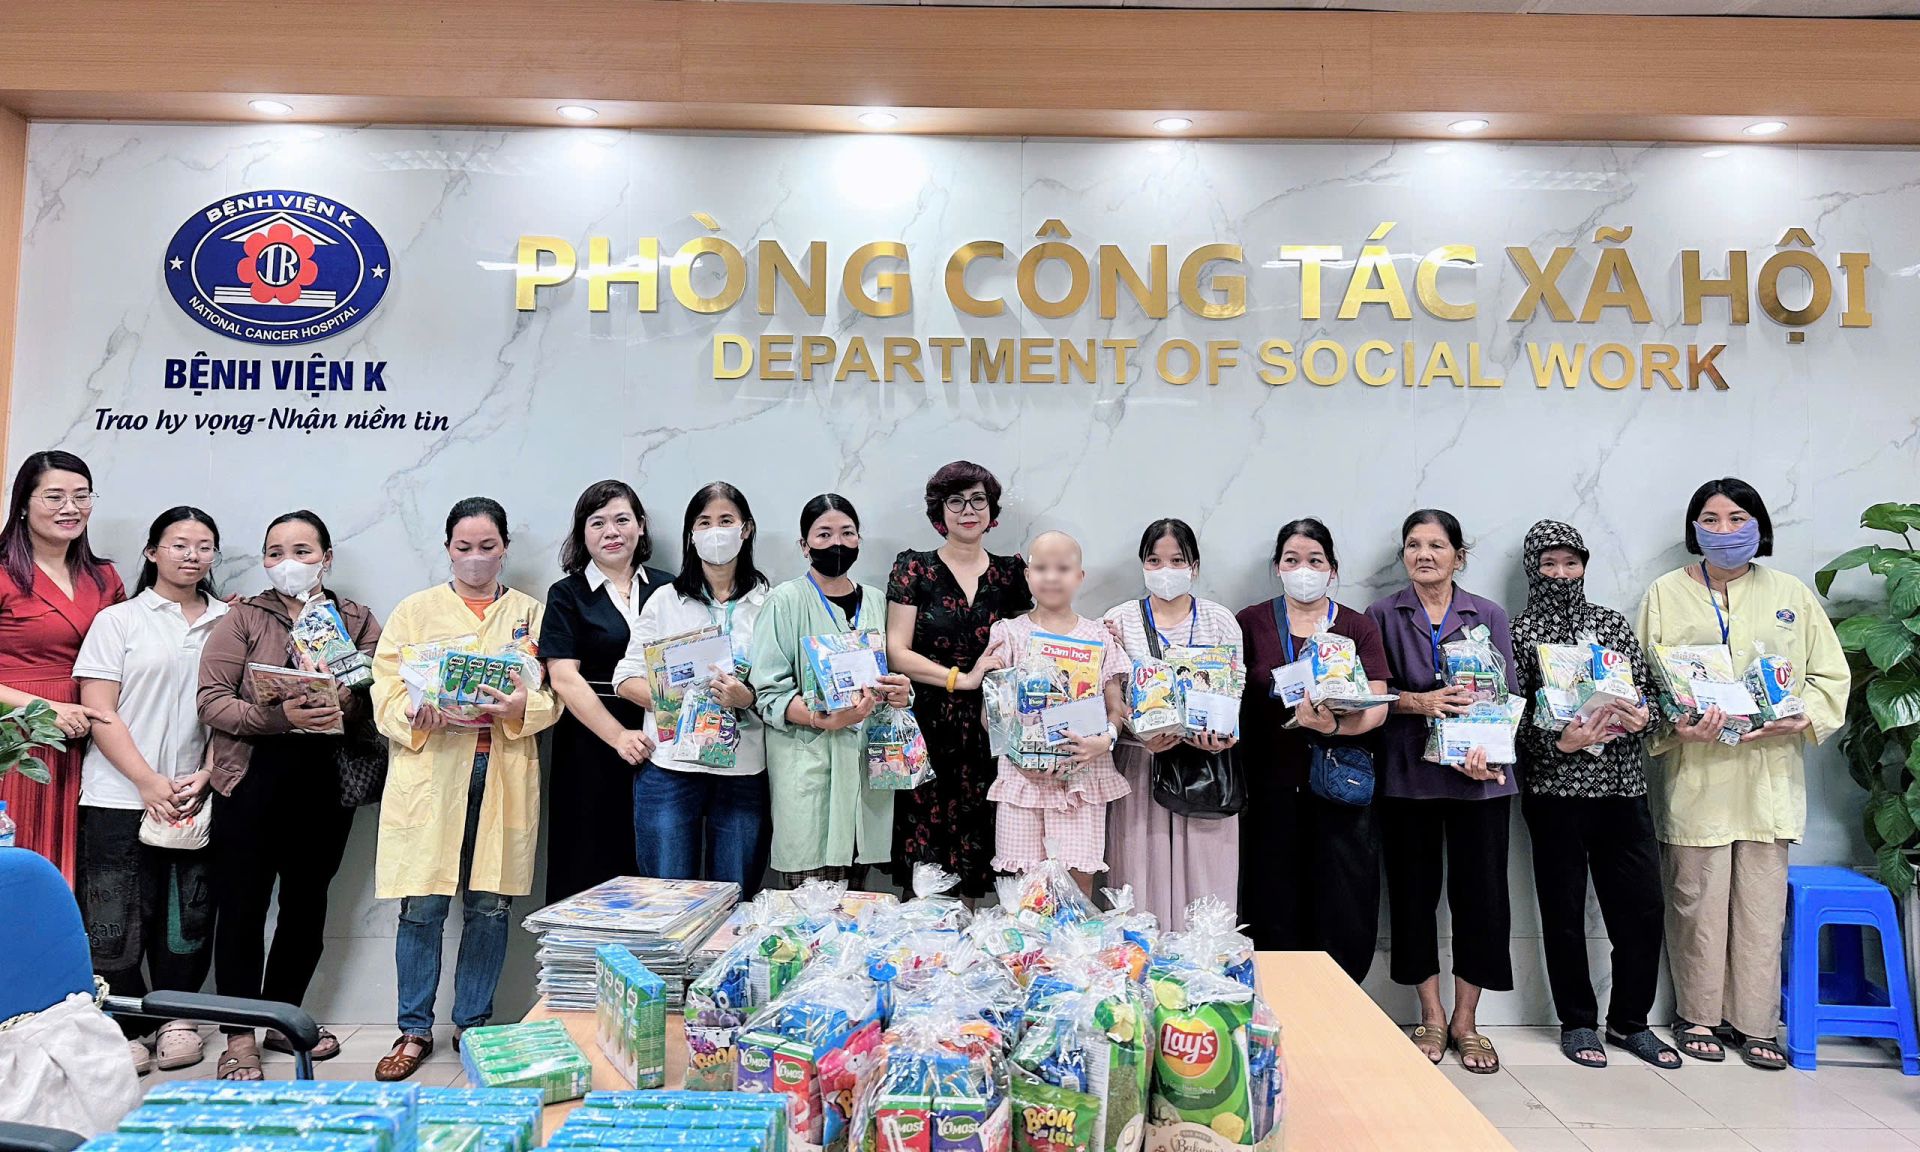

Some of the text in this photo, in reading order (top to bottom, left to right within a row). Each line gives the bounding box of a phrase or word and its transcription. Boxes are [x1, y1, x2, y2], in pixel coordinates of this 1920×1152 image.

[206, 195, 357, 229] BỆNH VIỆN K
[516, 212, 1873, 345] PHÒNG CÔNG TÁC XÃ HỘI
[189, 296, 360, 341] NATIONAL CANCER HOSPITAL
[164, 351, 388, 398] BỆNH VIỆN K
[713, 335, 1730, 391] DEPARTMENT OF SOCIAL WORK
[95, 408, 149, 431] Trao
[156, 408, 188, 435] hy
[344, 404, 406, 430] niềm
[414, 410, 450, 432] tin
[1163, 1025, 1216, 1064] Lay's
